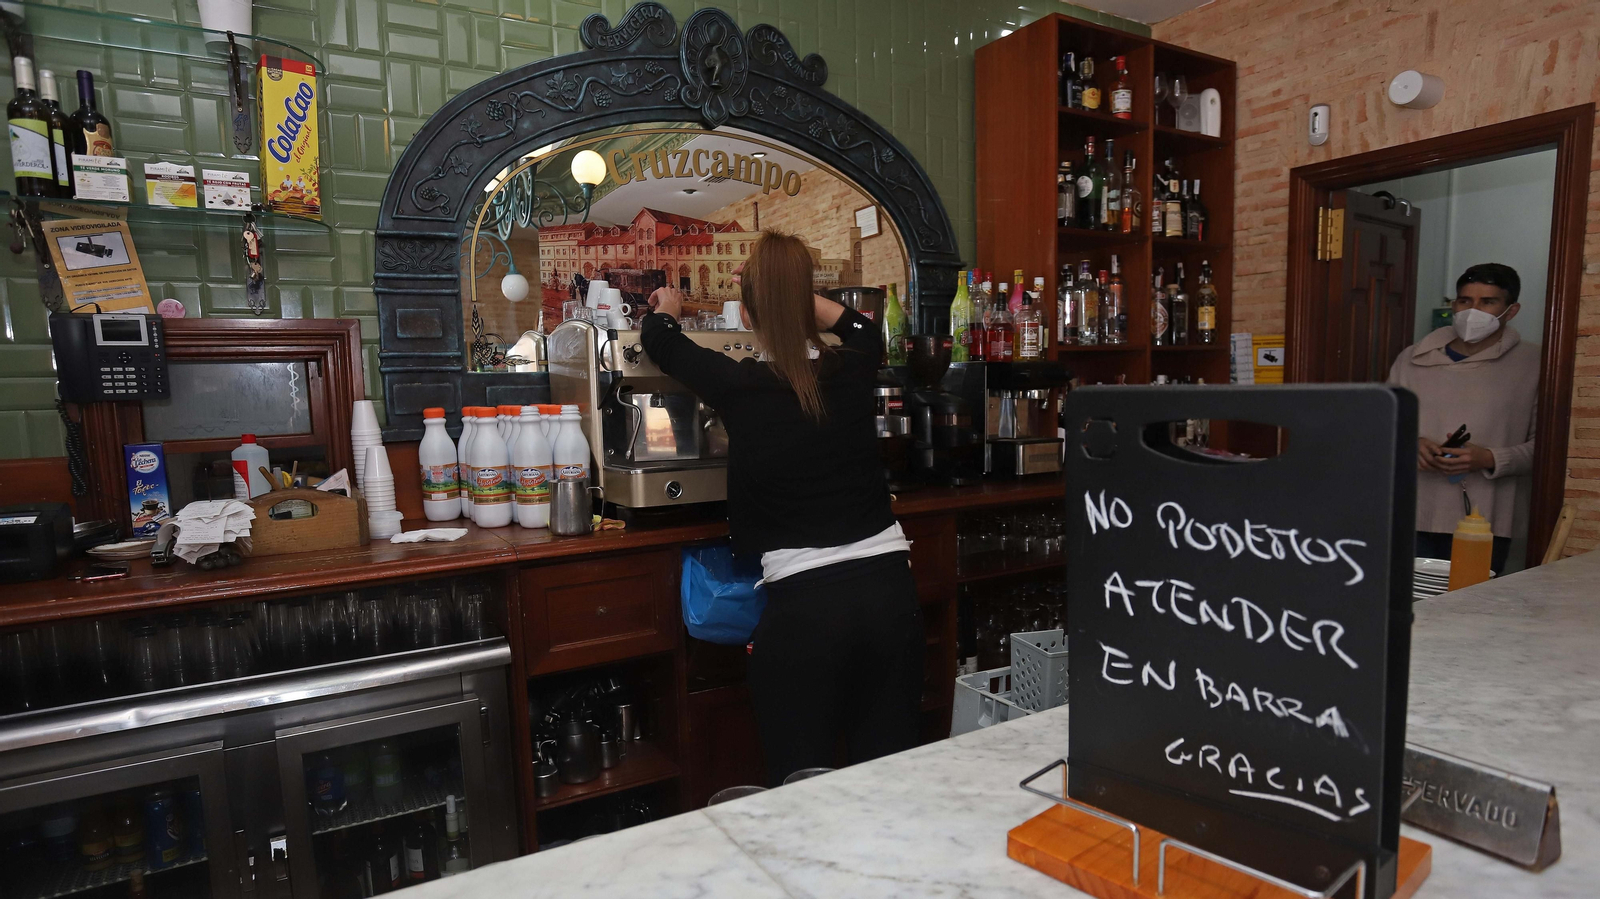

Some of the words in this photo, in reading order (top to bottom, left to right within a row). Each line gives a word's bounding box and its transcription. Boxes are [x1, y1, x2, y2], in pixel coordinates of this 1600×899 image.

[597, 6, 663, 47] CERVECERIA
[755, 29, 785, 48] CRUZ
[267, 81, 315, 164] ColaCao
[298, 124, 312, 156] Original
[607, 148, 802, 197] Cruzcampo
[70, 222, 122, 231] VIDEOVIGILADA
[1084, 489, 1133, 535] NO
[1156, 501, 1367, 586] PODEMOS
[1103, 571, 1359, 669] ATENDER
[1097, 640, 1176, 691] EN
[1195, 667, 1349, 738] BARRA
[1164, 737, 1371, 817] GRACIAS
